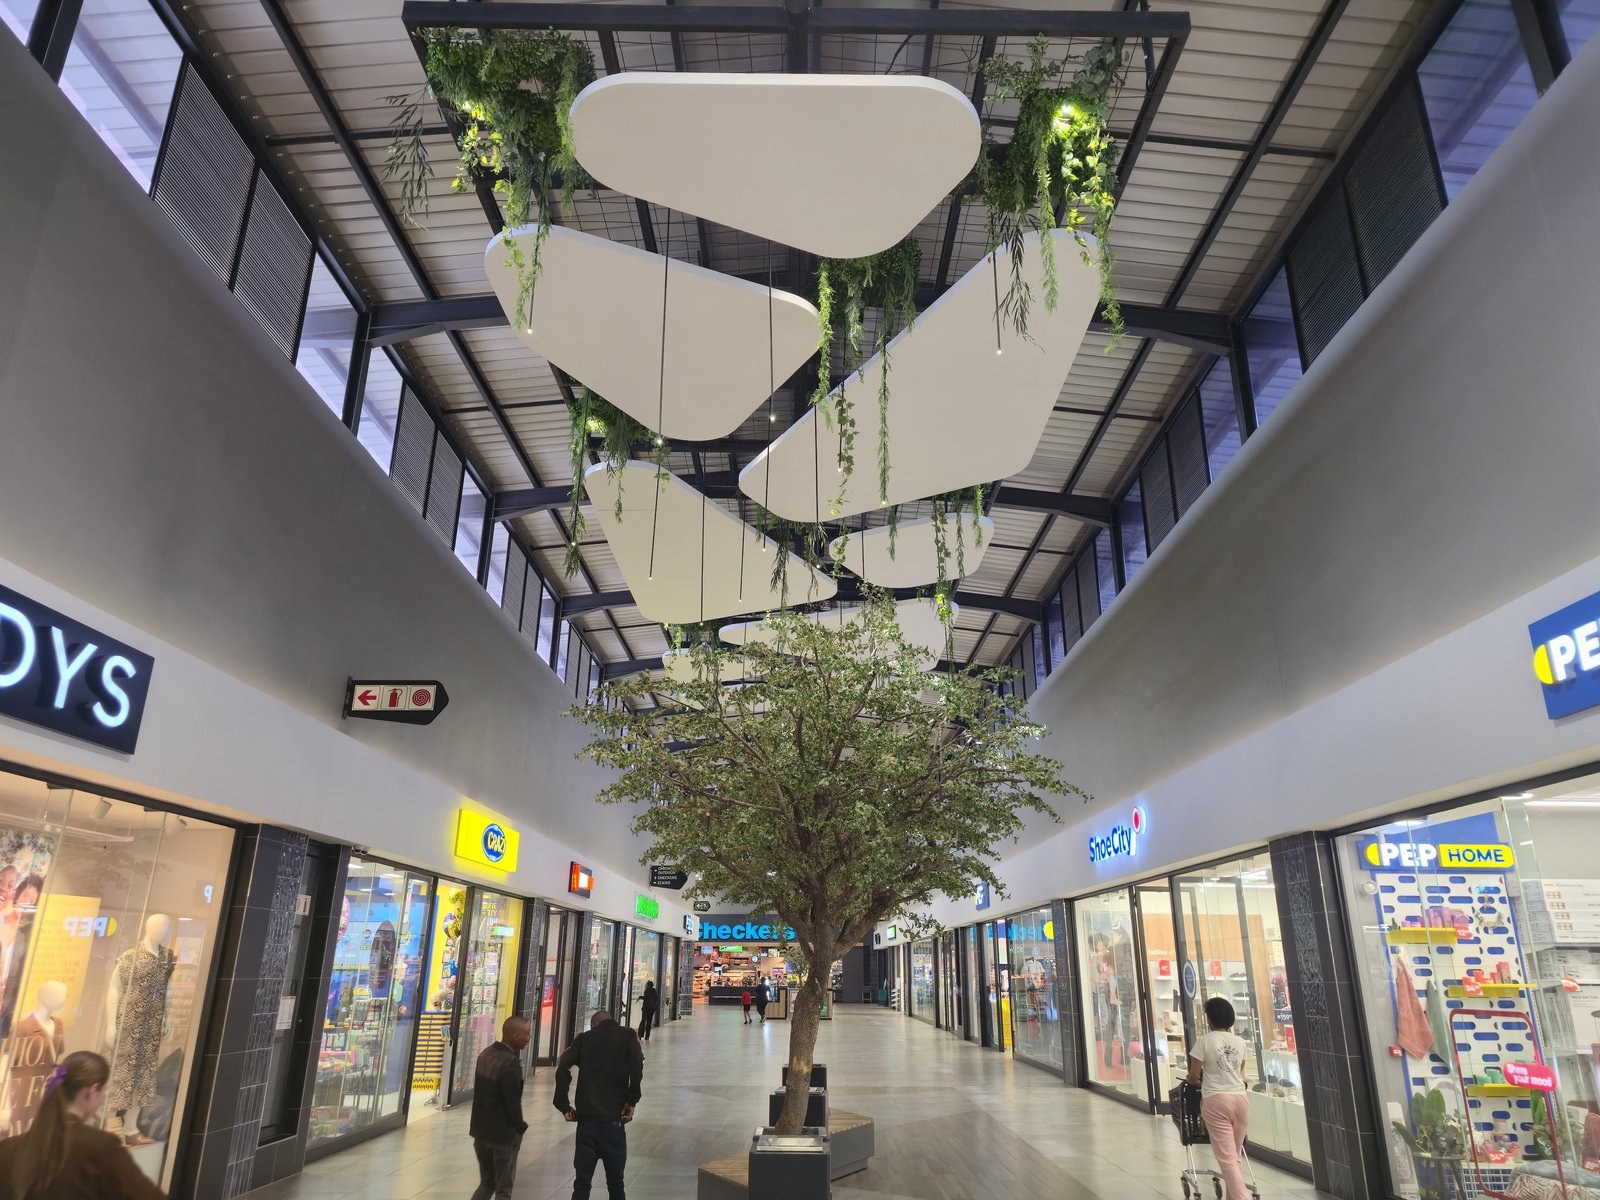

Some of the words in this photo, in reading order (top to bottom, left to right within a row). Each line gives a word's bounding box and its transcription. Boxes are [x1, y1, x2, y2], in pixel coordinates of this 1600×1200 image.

[1548, 617, 1600, 682] PE
[1089, 825, 1131, 862] ShoeCity
[1380, 842, 1437, 867] PEP
[1447, 848, 1505, 863] HOME
[1507, 1063, 1528, 1075] Share
[1513, 1074, 1529, 1084] your
[1531, 1076, 1553, 1087] mood
